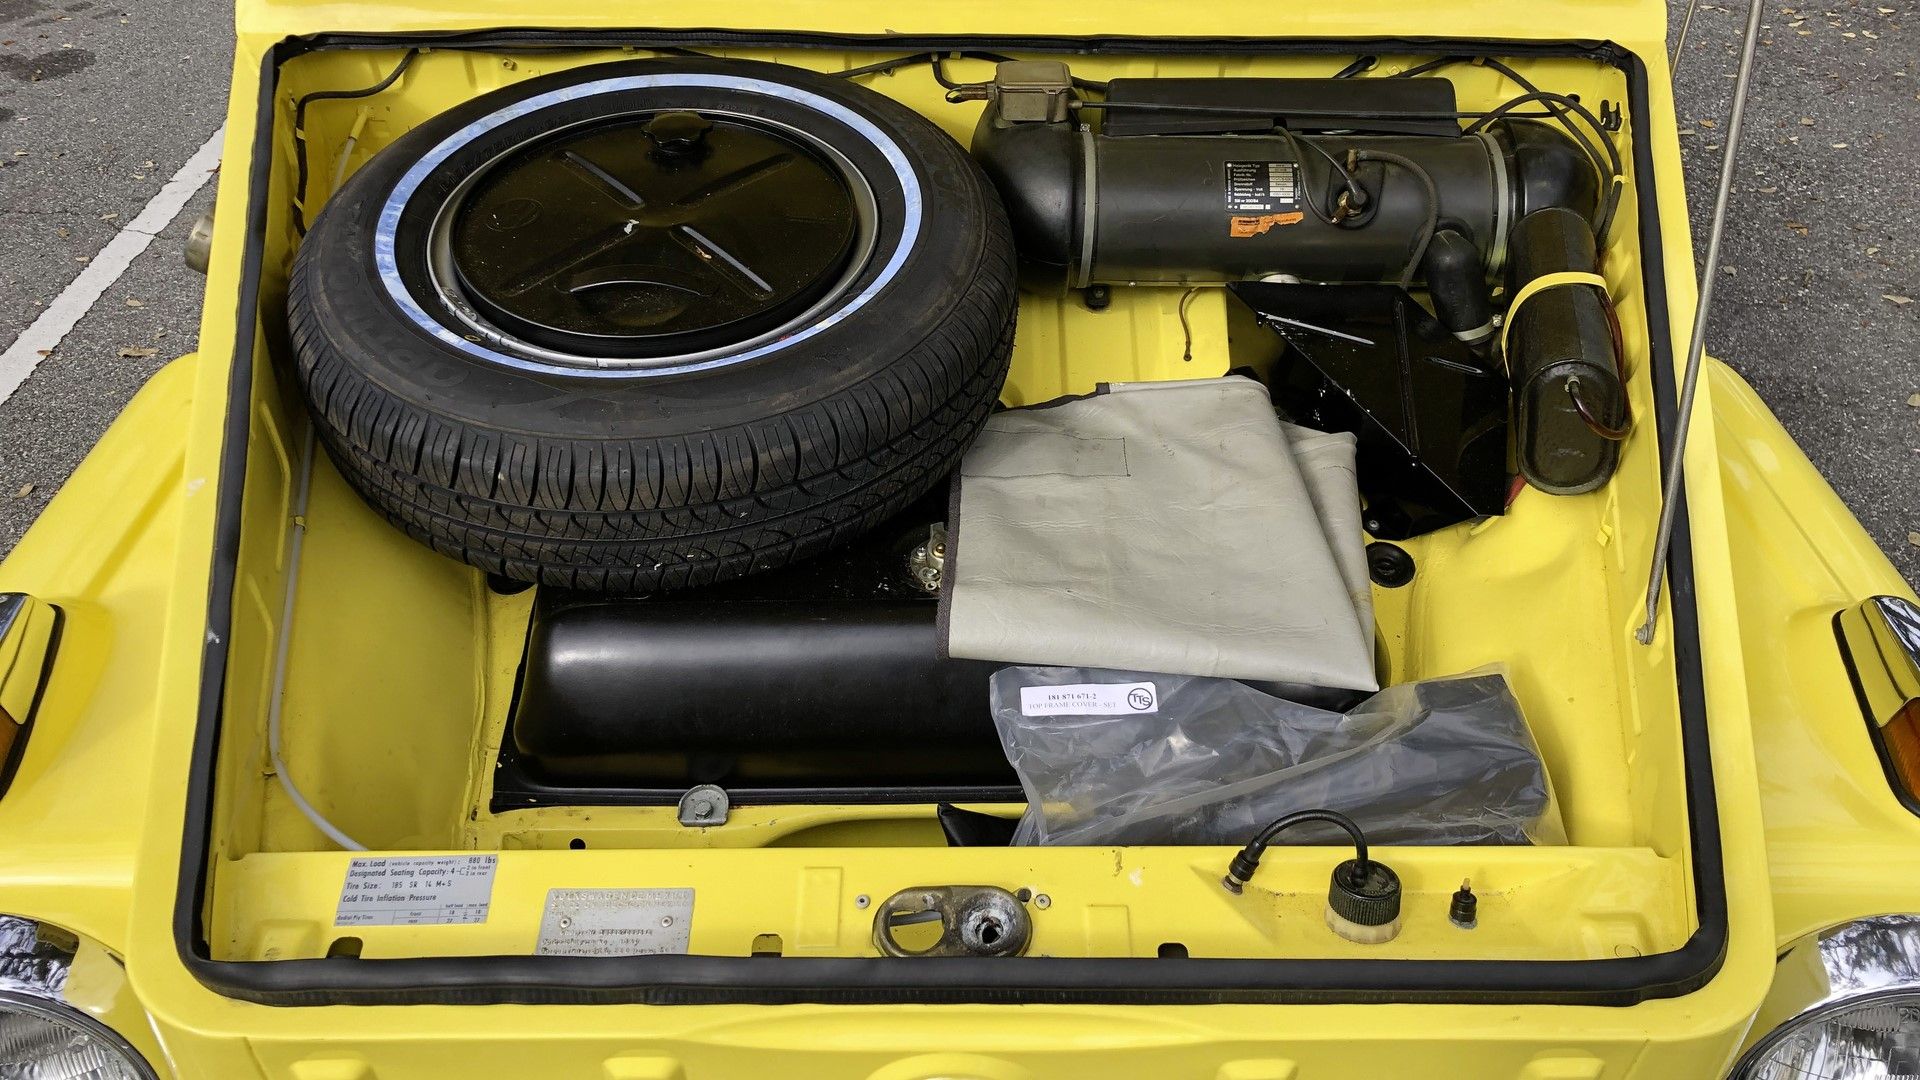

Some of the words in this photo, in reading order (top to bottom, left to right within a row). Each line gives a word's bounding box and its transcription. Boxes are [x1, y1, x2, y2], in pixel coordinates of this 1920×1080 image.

[1076, 692, 1097, 700] 671-2
[1130, 693, 1151, 706] TTS
[369, 859, 387, 868] Load
[484, 856, 496, 864] lbs
[349, 869, 387, 878] Designated
[390, 869, 415, 878] Seating
[418, 867, 449, 877] Capacity:
[450, 867, 455, 875] 4
[409, 880, 418, 889] SR
[342, 894, 358, 903] Cold
[361, 894, 374, 902] Tire
[376, 893, 406, 902] Inflation
[408, 893, 437, 901] Pressure
